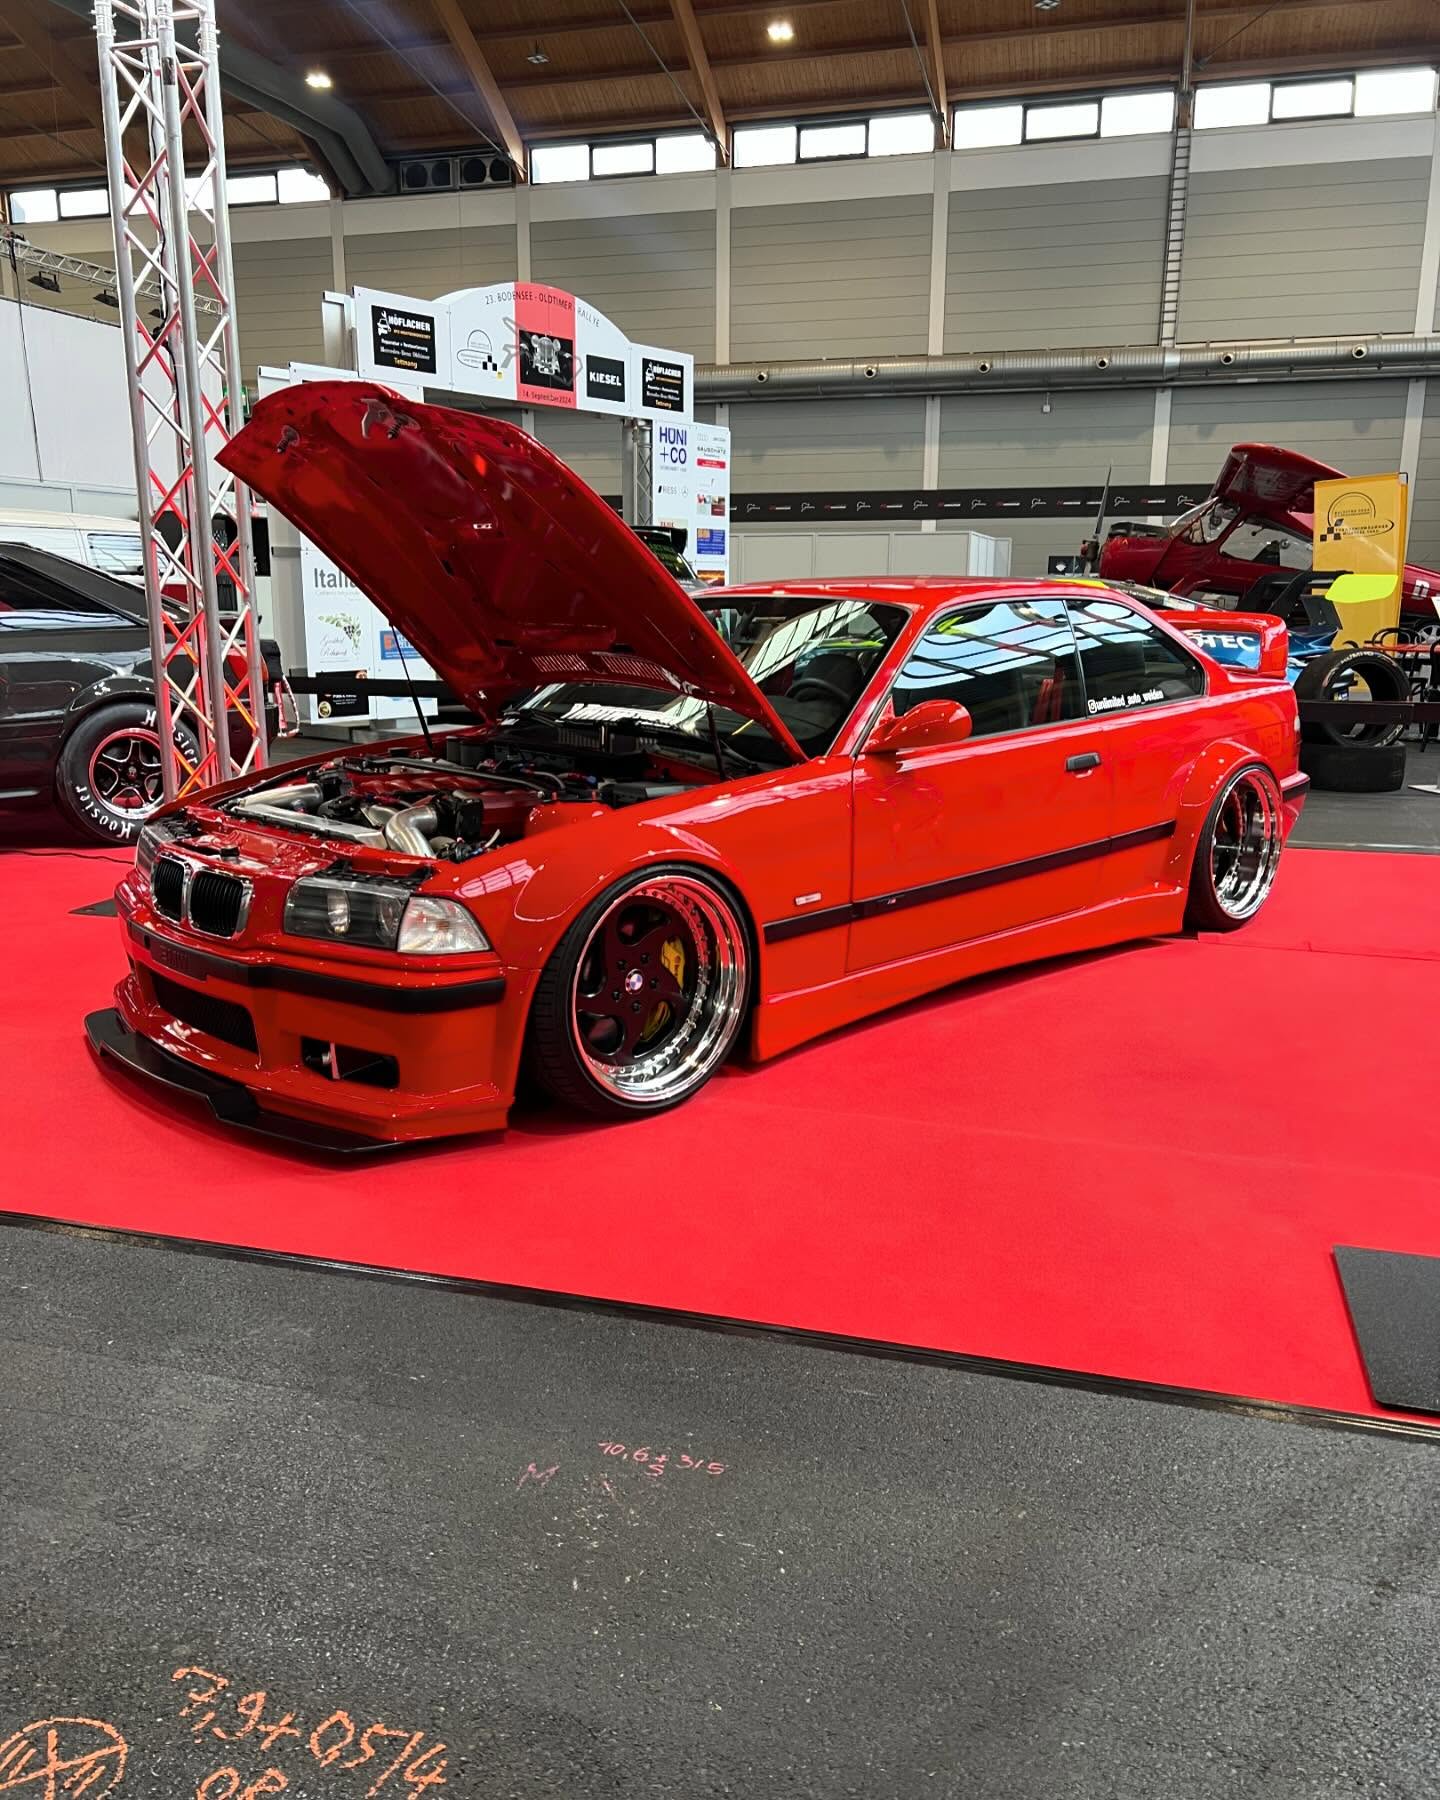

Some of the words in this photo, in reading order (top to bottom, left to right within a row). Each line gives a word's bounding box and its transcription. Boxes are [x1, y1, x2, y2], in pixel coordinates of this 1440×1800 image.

[497, 291, 533, 302] BODENSEE
[538, 292, 573, 311] OLDTIMER
[577, 306, 600, 328] RALLYE
[388, 314, 431, 332] HÖFLACHER
[589, 371, 622, 386] KIESEL
[659, 426, 687, 446] HÜNI
[75, 784, 136, 840] Hoosier
